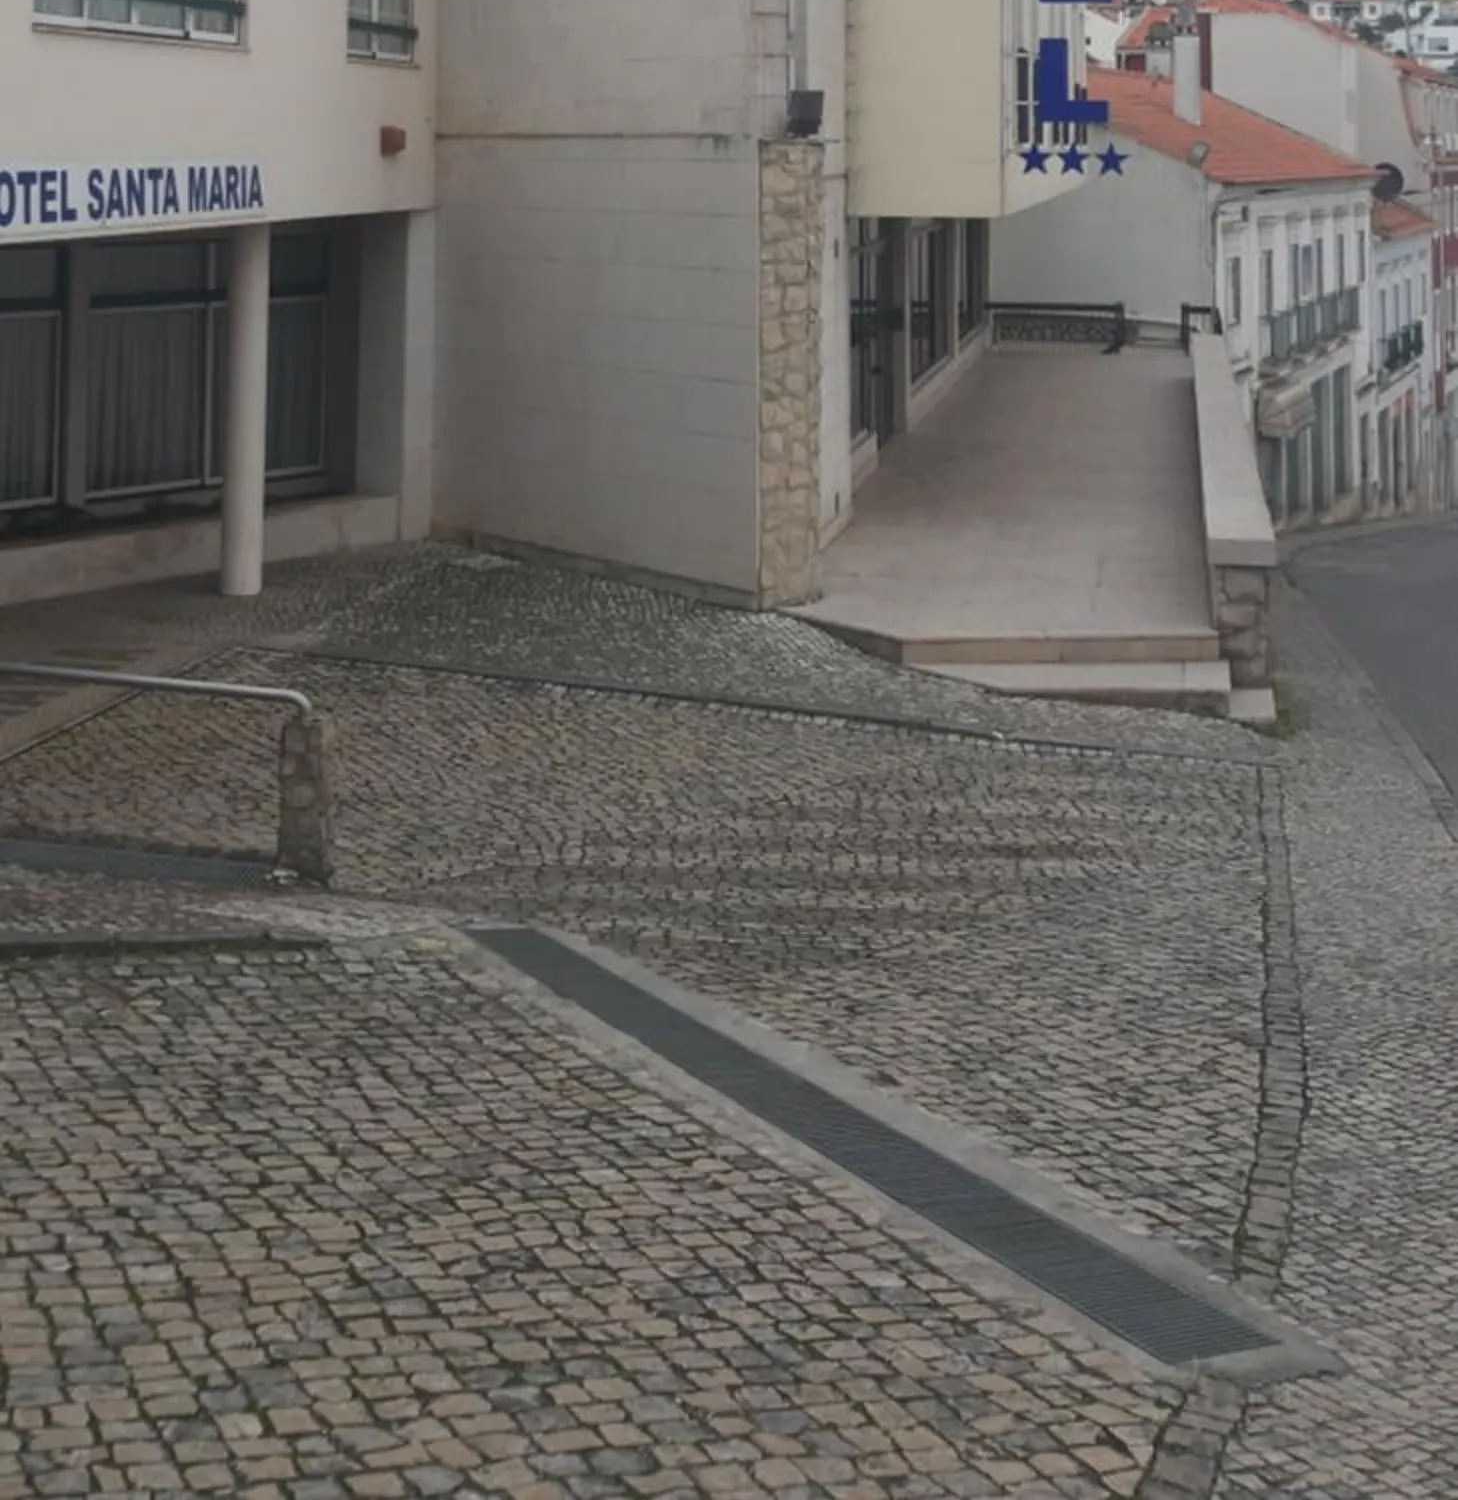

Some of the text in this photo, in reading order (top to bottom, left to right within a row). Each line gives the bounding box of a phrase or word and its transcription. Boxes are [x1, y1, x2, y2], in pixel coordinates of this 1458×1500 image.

[0, 164, 264, 227] OTEL SANTA MARIA
